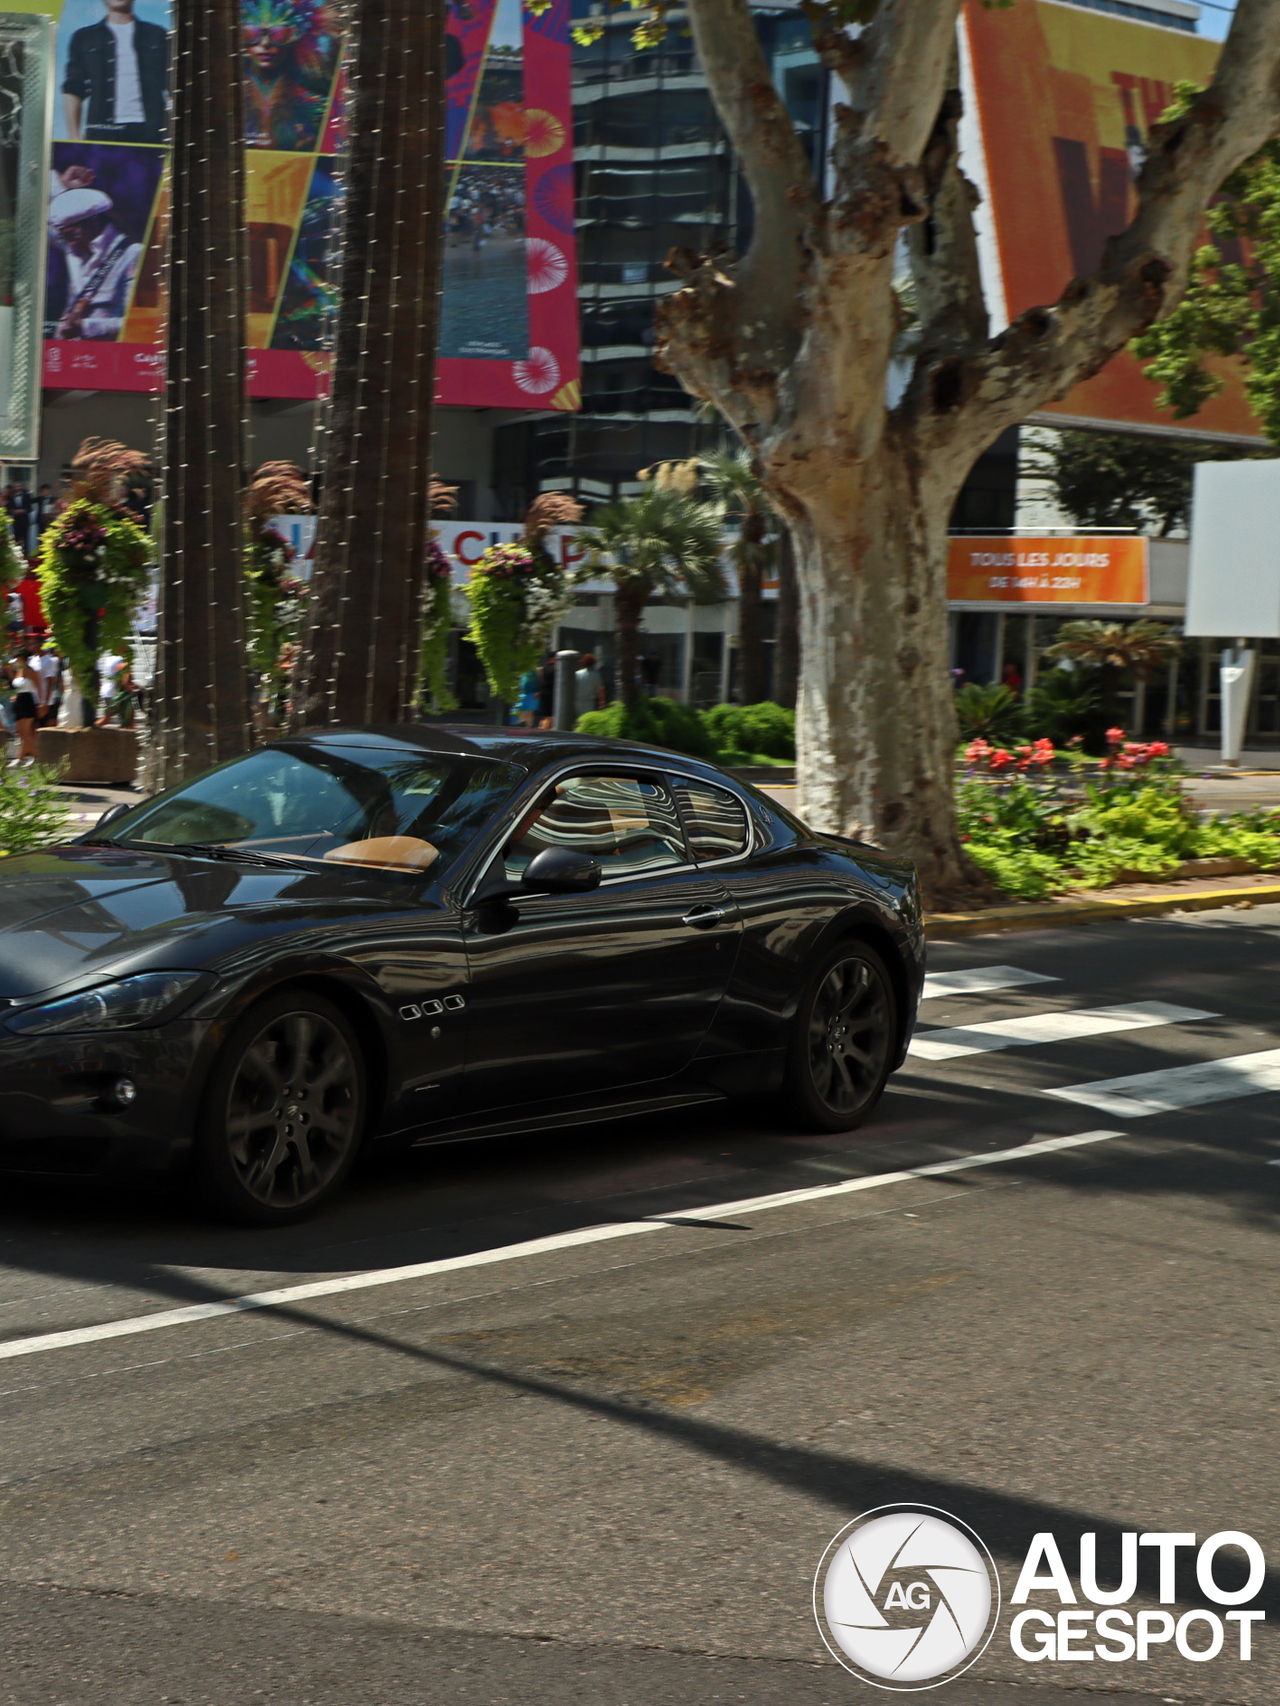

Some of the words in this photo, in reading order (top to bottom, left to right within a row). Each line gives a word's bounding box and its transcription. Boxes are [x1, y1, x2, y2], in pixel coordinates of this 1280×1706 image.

[970, 552, 1015, 567] TOUS
[1017, 552, 1050, 567] LES
[1051, 553, 1111, 568] JOURS
[988, 576, 1010, 588] DE
[1051, 576, 1082, 589] 22H
